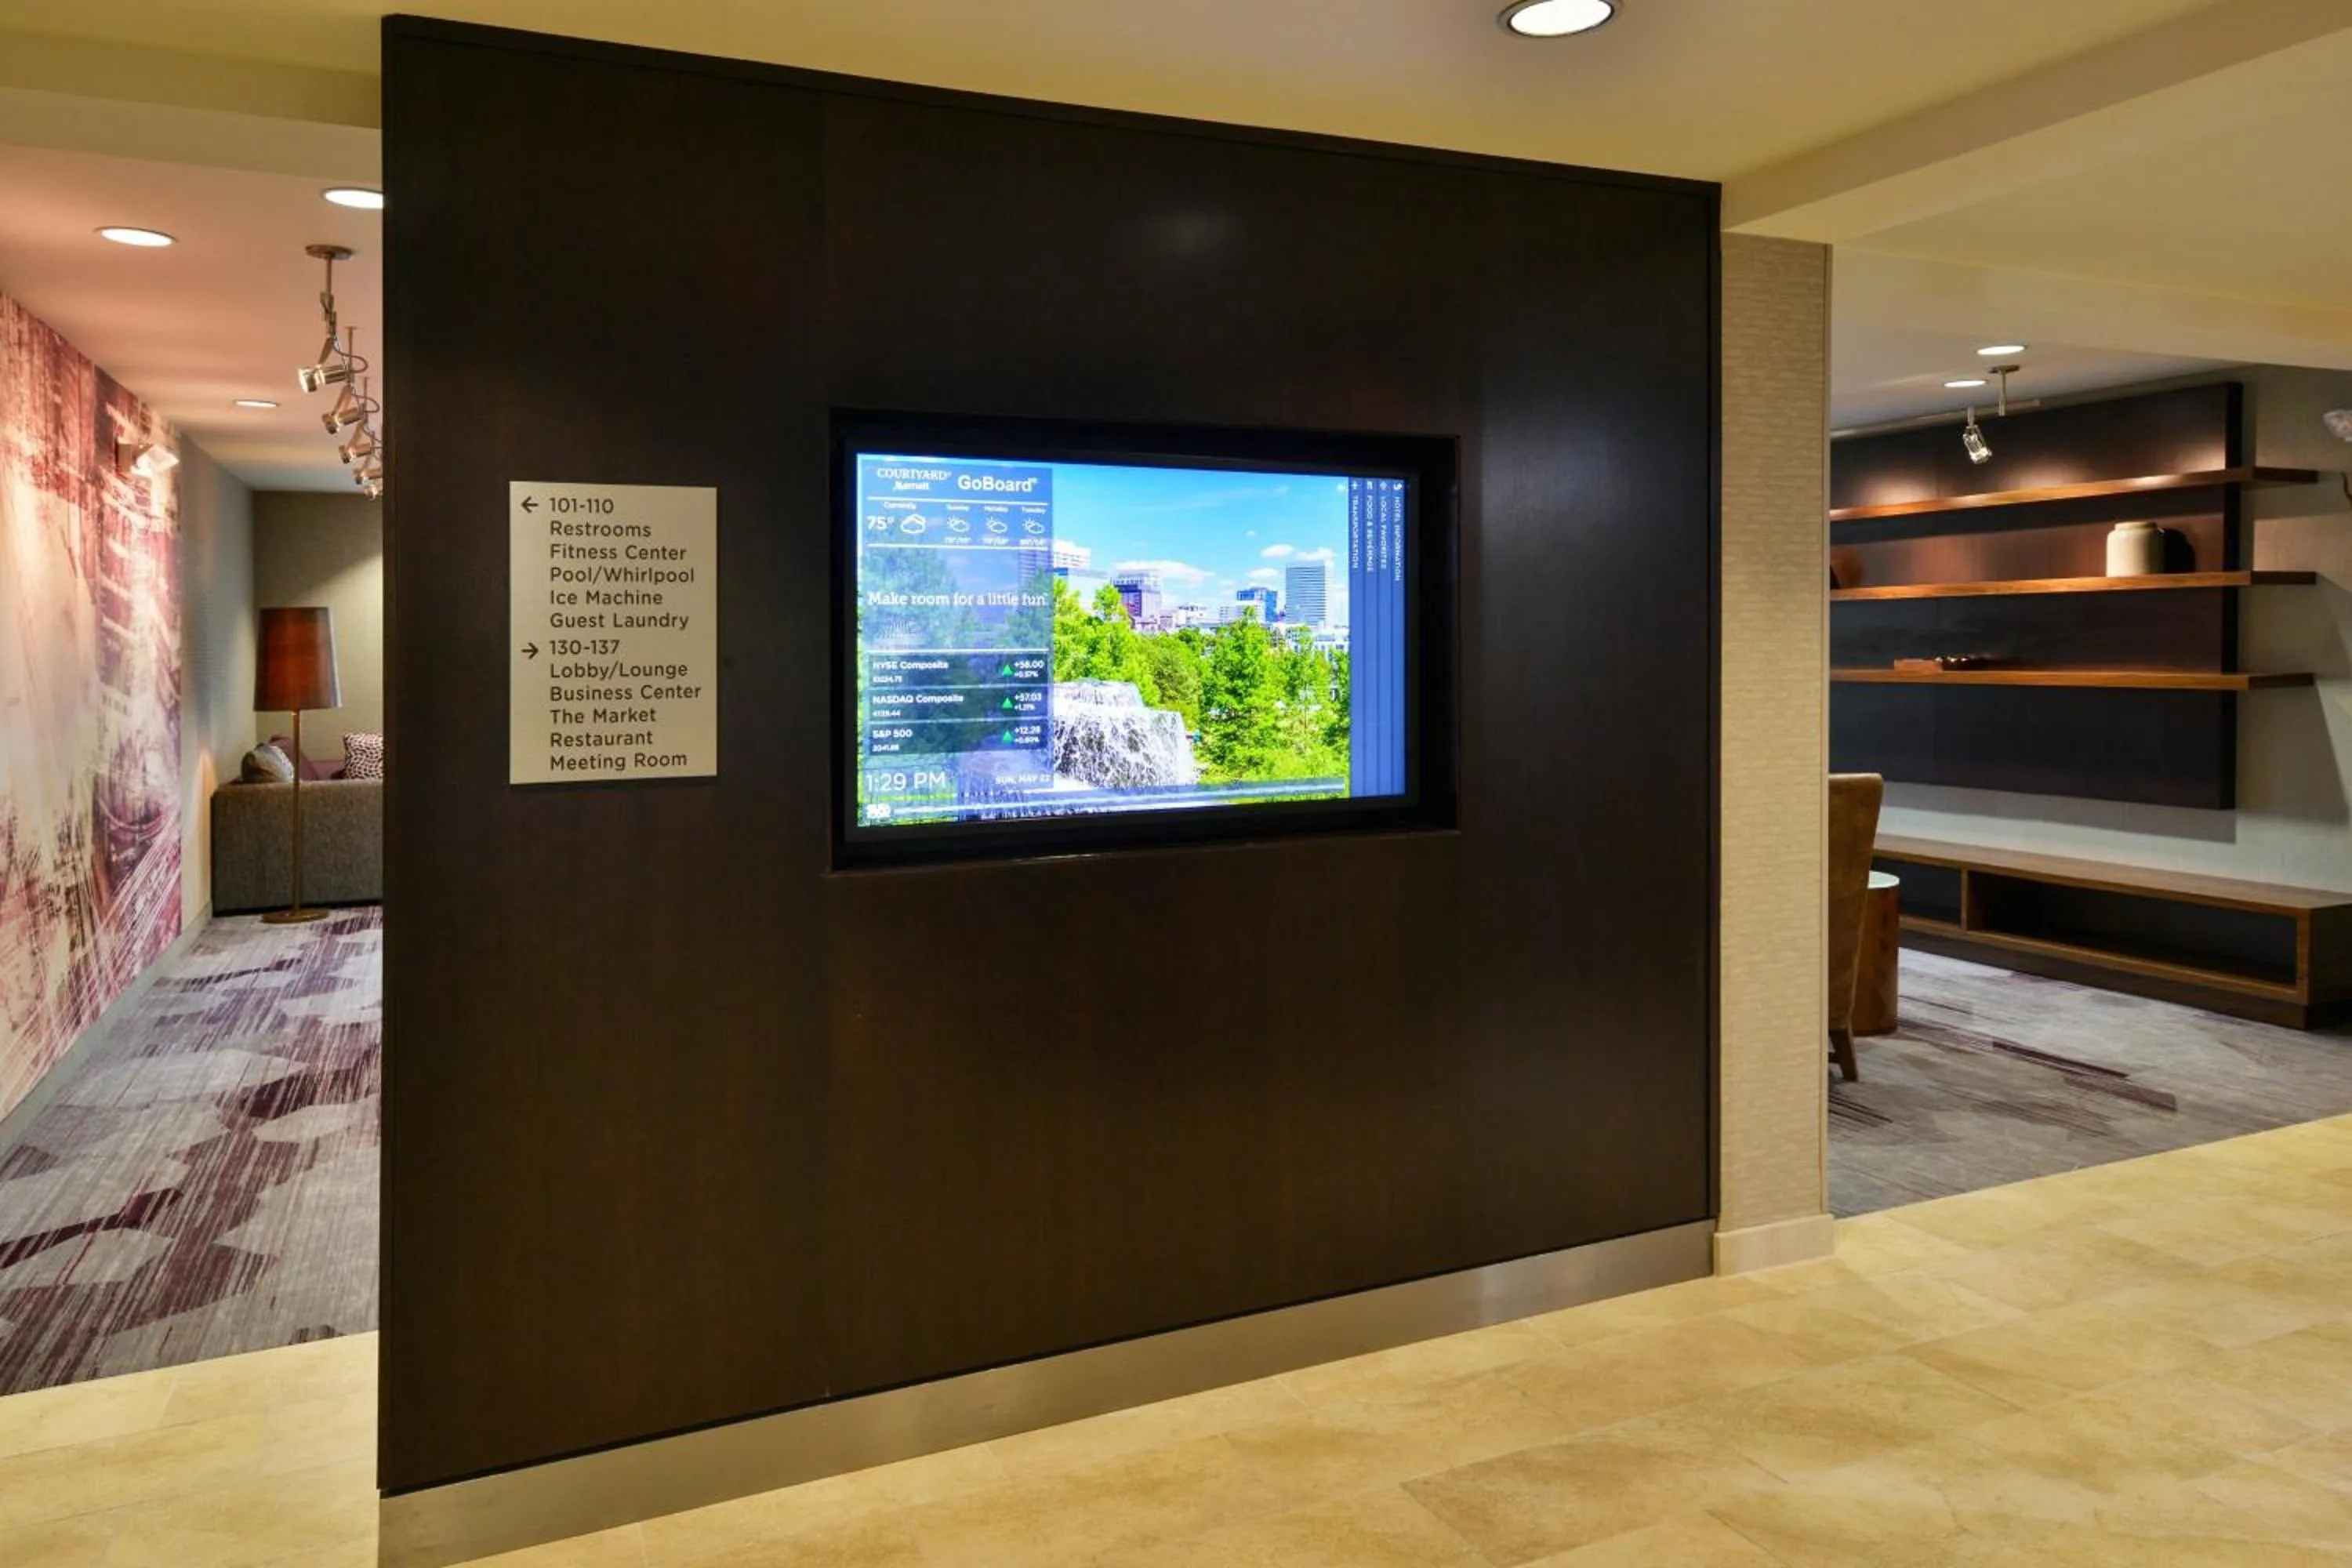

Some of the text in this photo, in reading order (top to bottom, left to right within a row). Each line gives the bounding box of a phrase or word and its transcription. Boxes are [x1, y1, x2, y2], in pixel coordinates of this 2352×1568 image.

[549, 497, 614, 514] 101-110
[550, 520, 652, 537] Restrooms
[550, 543, 687, 561] Fitness Center
[550, 566, 695, 586] Pool/Whirlpool
[550, 590, 663, 605] Ice Machine
[868, 592, 907, 606] Make
[911, 593, 949, 605] room
[953, 592, 974, 606] for
[977, 596, 985, 606] a
[988, 592, 1018, 606] little
[550, 612, 689, 630] Guest Laundry
[549, 639, 620, 655] 130-137
[550, 661, 688, 681] Lobby/Lounge
[900, 660, 949, 670] Composite
[550, 684, 702, 701] Business Center
[873, 695, 964, 704] NASDAQ Composite
[550, 707, 656, 724] The Market
[550, 731, 653, 747] Restaurant
[893, 728, 913, 738] 500
[550, 753, 688, 771] Meeting Room
[866, 771, 947, 792] 1:29 PM
